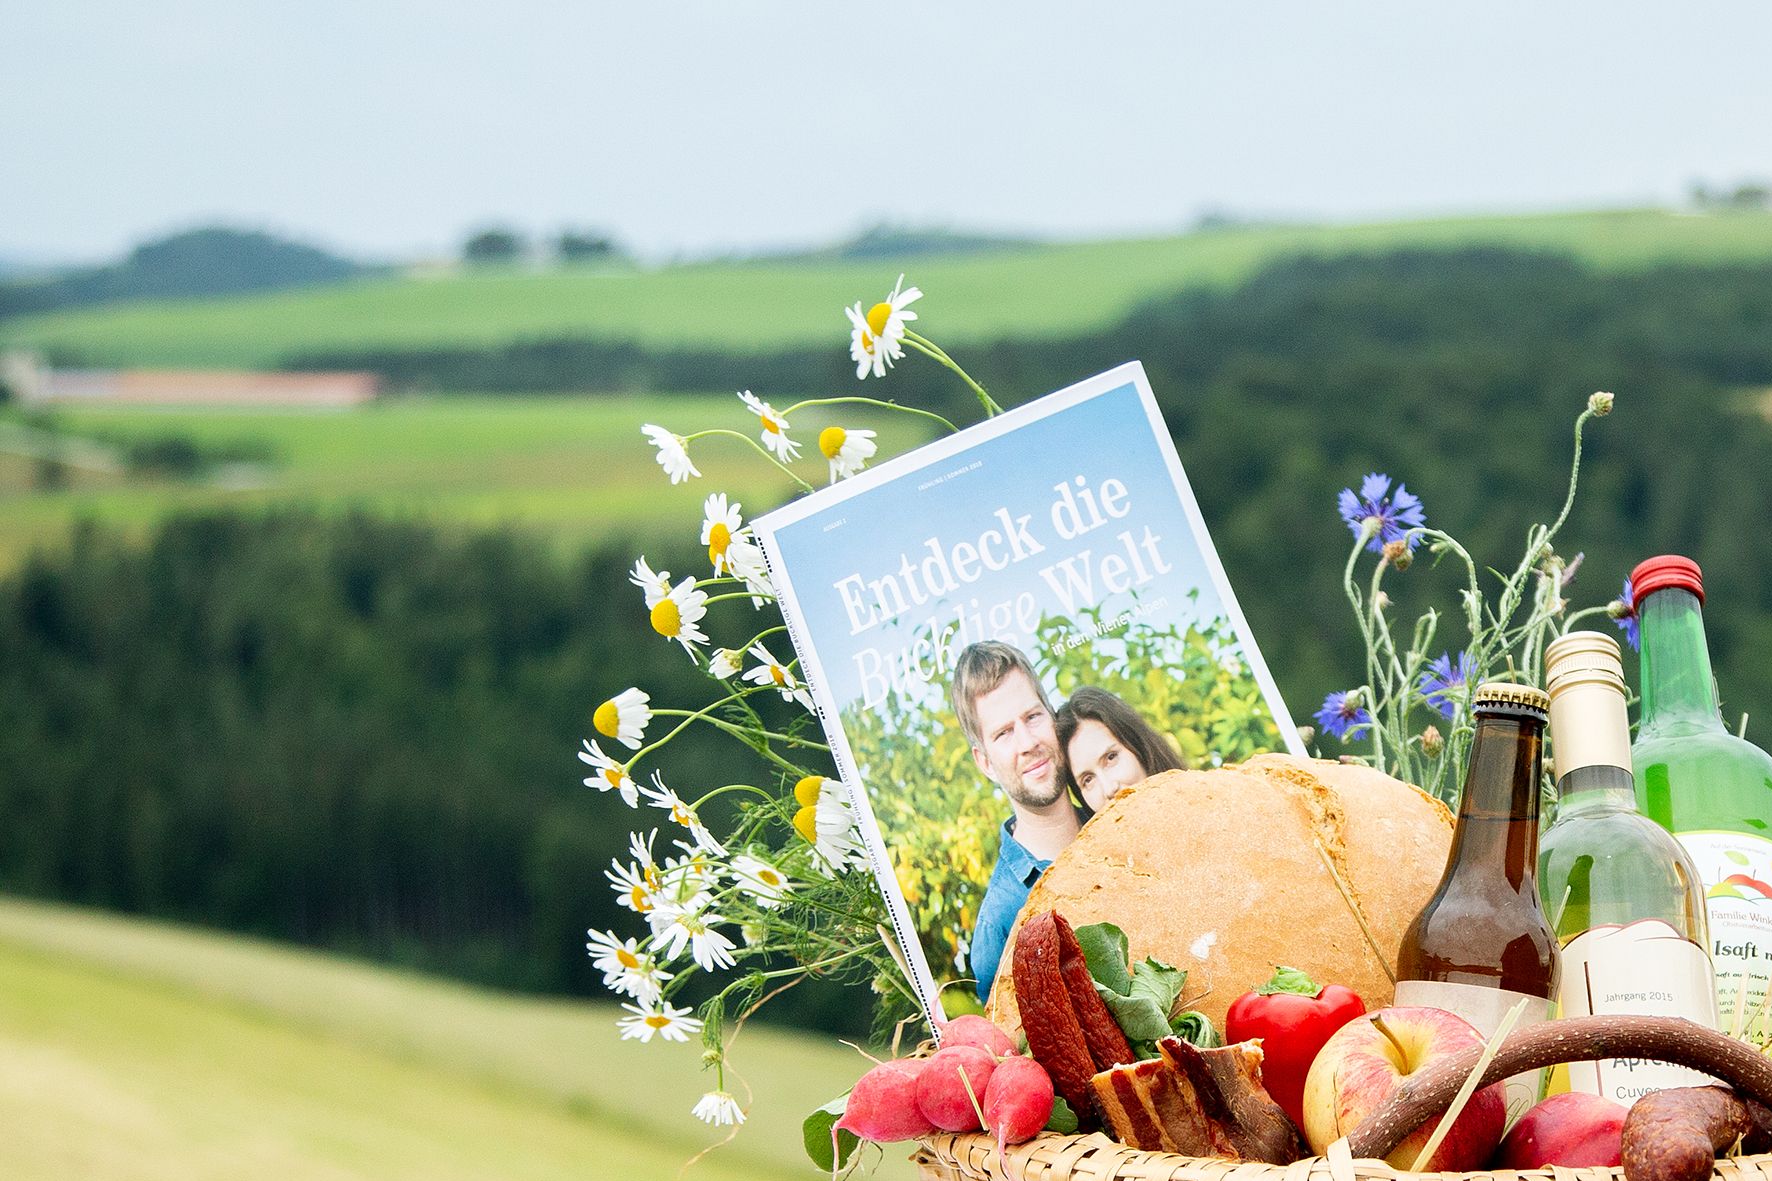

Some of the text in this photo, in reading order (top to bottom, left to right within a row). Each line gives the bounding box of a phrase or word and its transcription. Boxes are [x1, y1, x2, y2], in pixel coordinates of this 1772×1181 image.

[833, 474, 1131, 636] Entdeck die
[852, 525, 1172, 711] Bucklige Welt
[1051, 596, 1169, 656] in den Wiener Alpen
[774, 587, 817, 691] ENTDECK DIE BUCKLIGE WELT
[827, 733, 838, 751] 2018
[833, 752, 849, 782] SOMMER
[866, 843, 883, 875] AUSGABE
[1711, 910, 1747, 921] Familie
[1715, 940, 1758, 960] lsaft
[1604, 991, 1674, 1003] Jahrgang 2015
